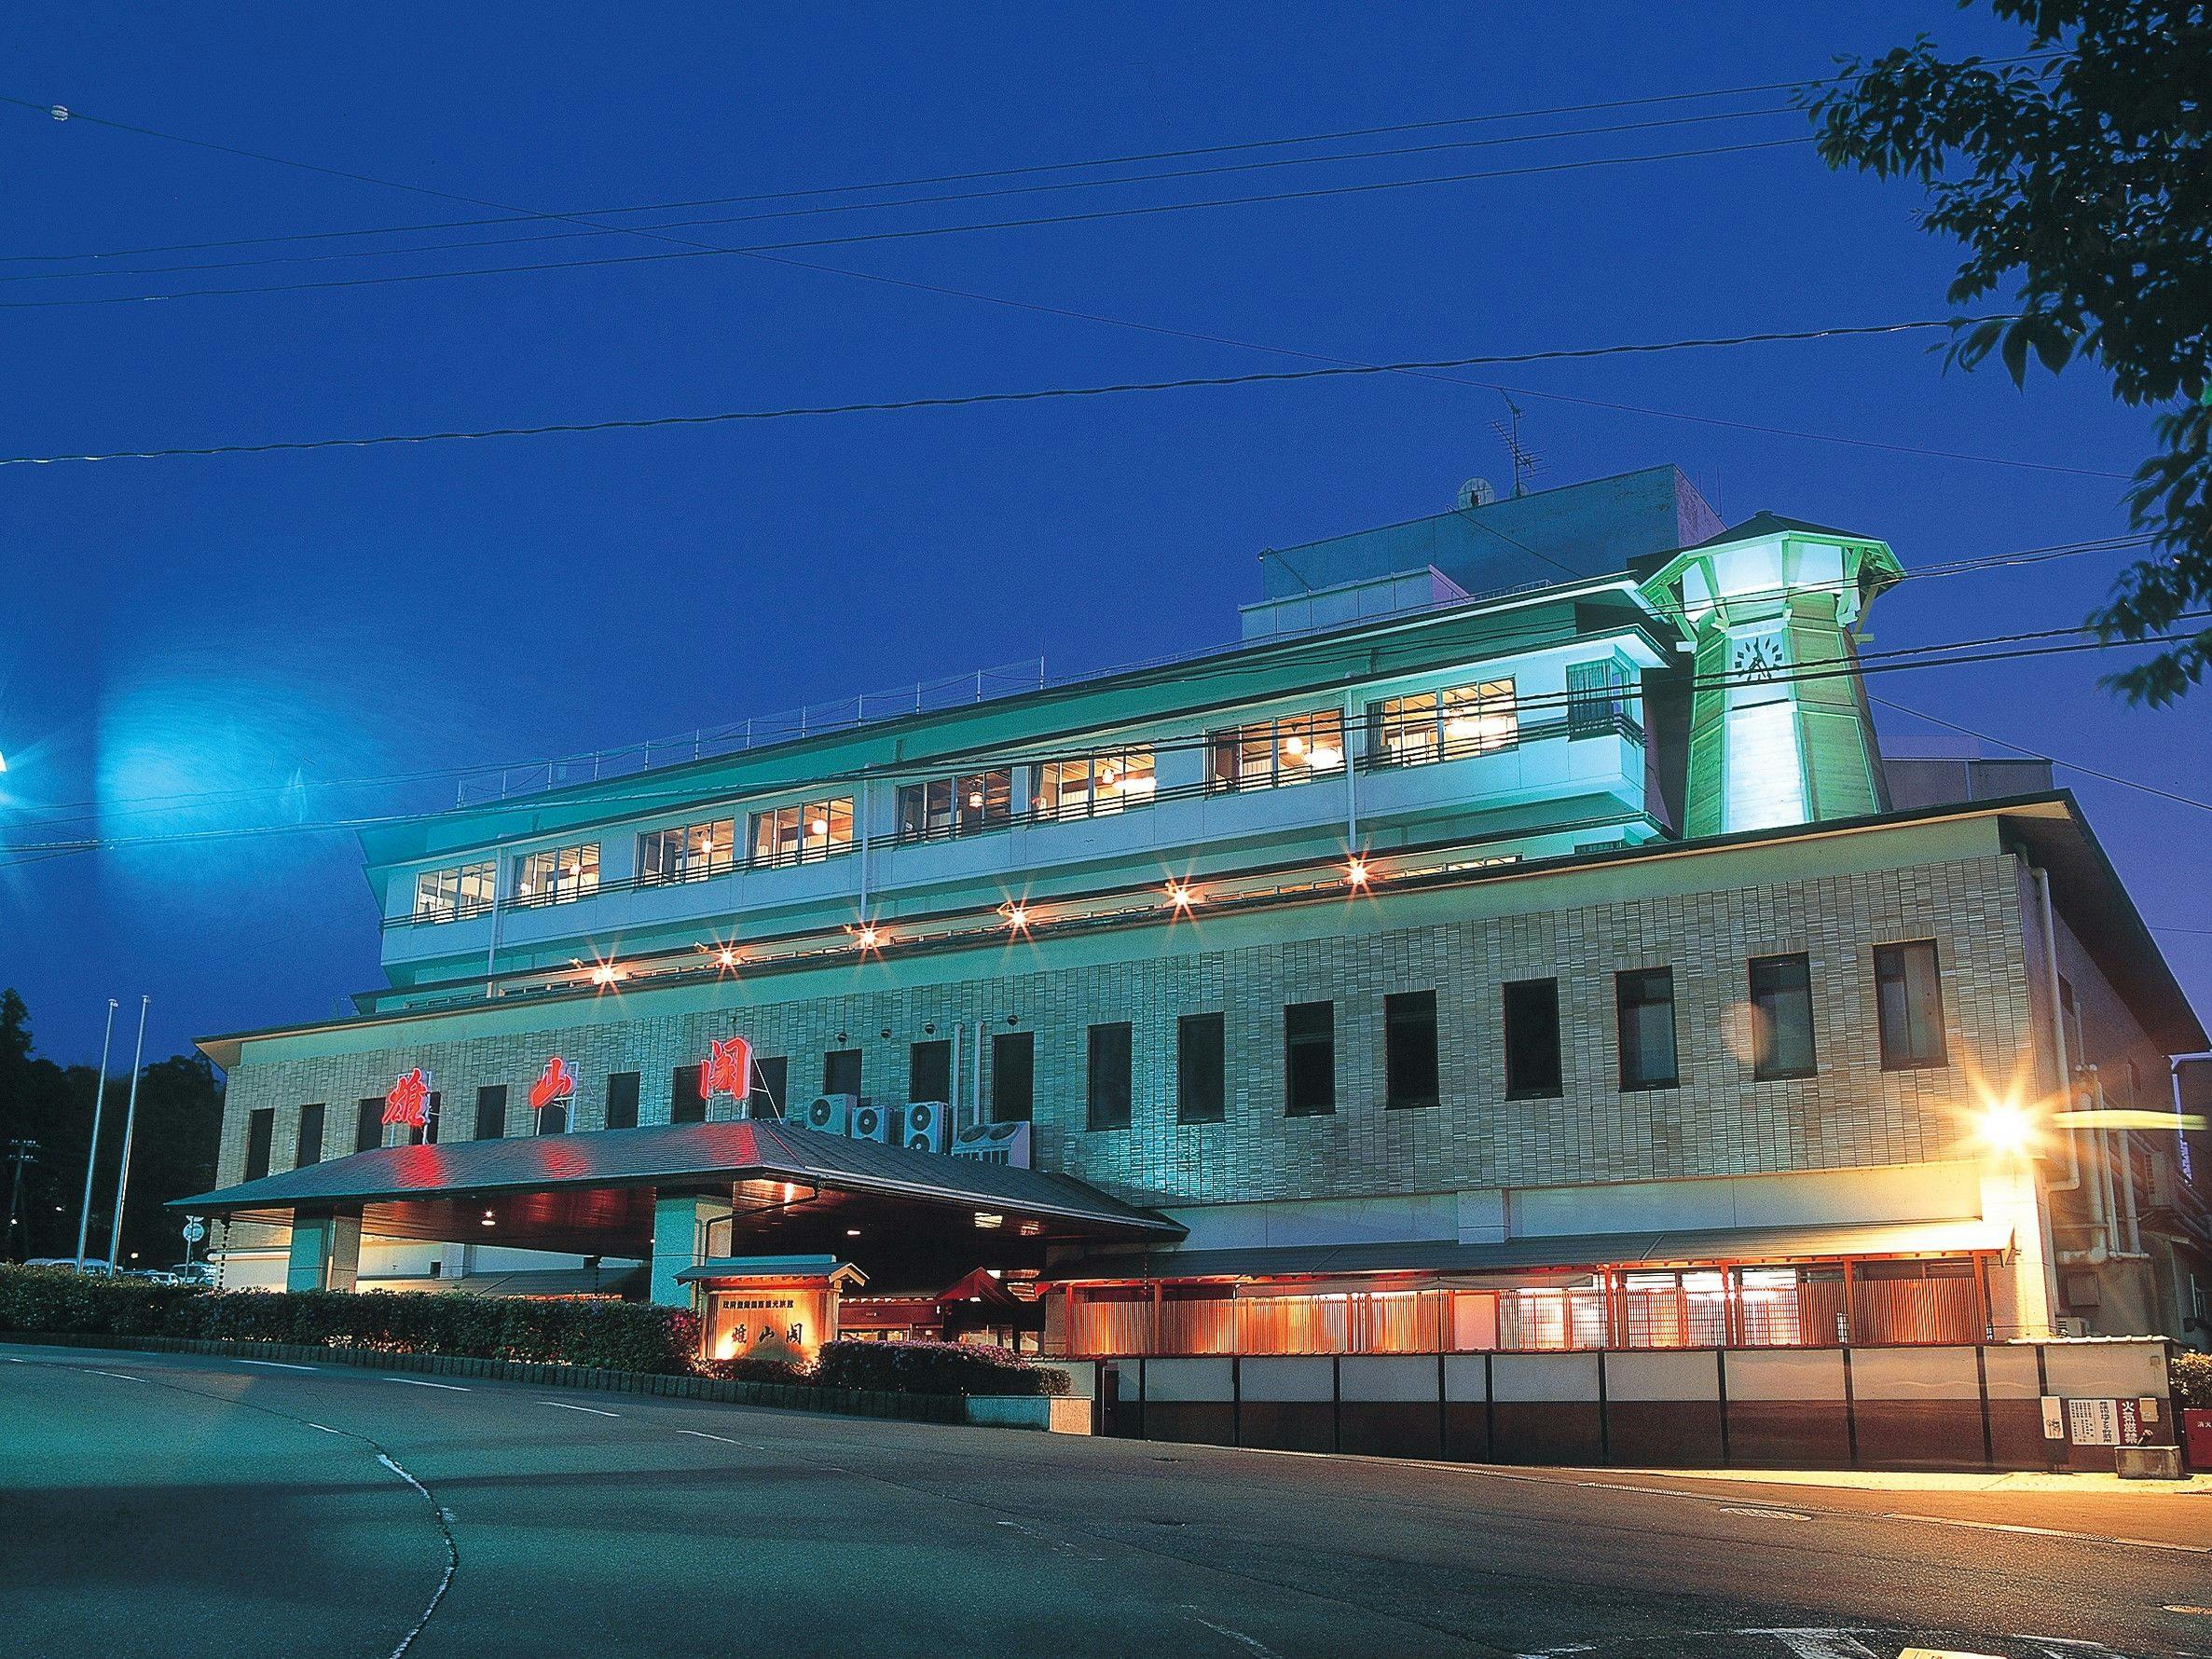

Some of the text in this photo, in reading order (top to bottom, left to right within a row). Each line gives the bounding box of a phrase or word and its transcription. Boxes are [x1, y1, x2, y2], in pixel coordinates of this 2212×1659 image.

[382, 1037, 750, 1126] 雄山閣
[732, 1323, 803, 1346] 雄山閣
[2122, 1401, 2137, 1444] 火気厳禁
